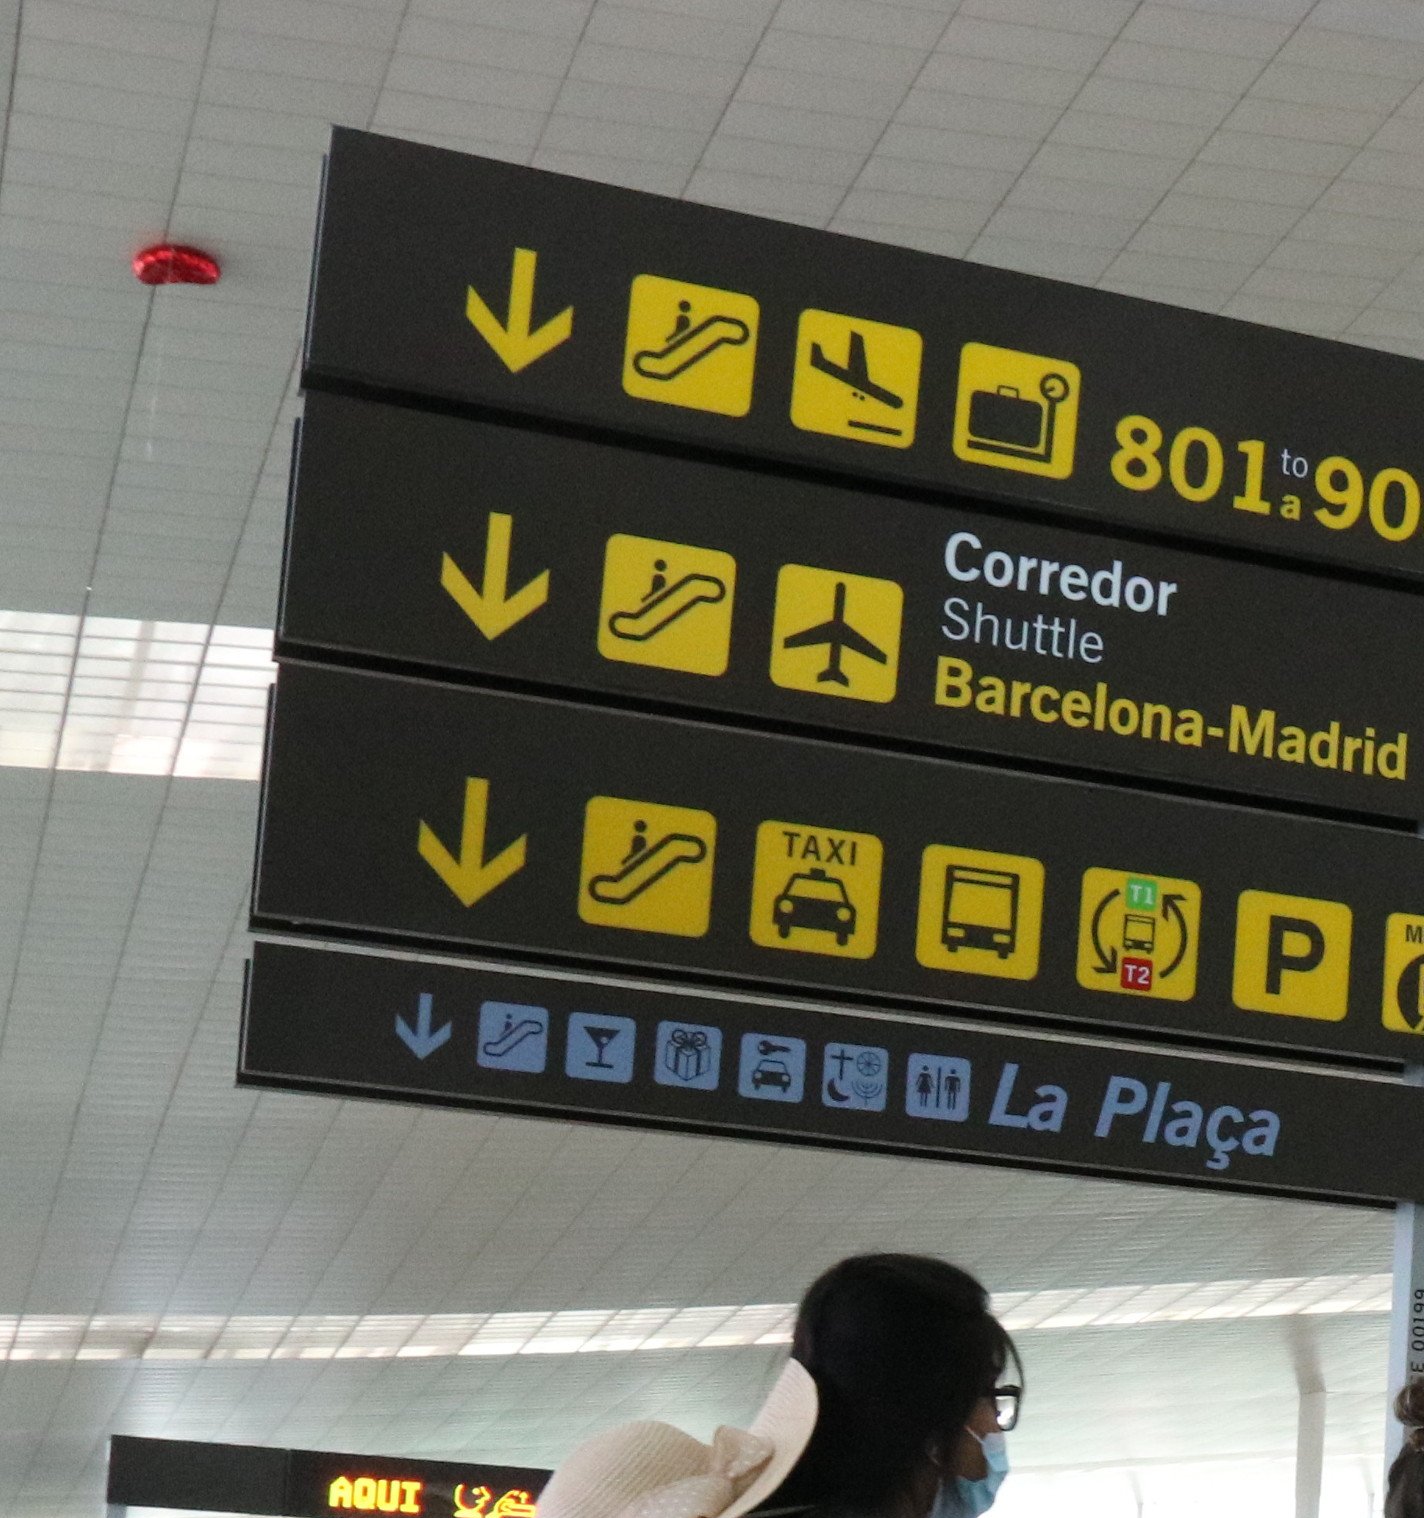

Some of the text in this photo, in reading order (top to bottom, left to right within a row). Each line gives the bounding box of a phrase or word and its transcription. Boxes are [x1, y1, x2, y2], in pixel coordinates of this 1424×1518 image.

[1111, 414, 1272, 516] 801
[1281, 447, 1308, 479] to
[1280, 493, 1302, 522] a
[944, 531, 1177, 617] Corredor
[941, 597, 1105, 664] Shuttle
[934, 656, 1409, 782] Barcelona-Madrid
[782, 831, 859, 867] TAXI
[1129, 882, 1156, 907] T1
[1122, 961, 1151, 987] T2
[1266, 913, 1326, 995] P
[987, 1063, 1283, 1172] La Plaça
[328, 1476, 421, 1513] AQUI
